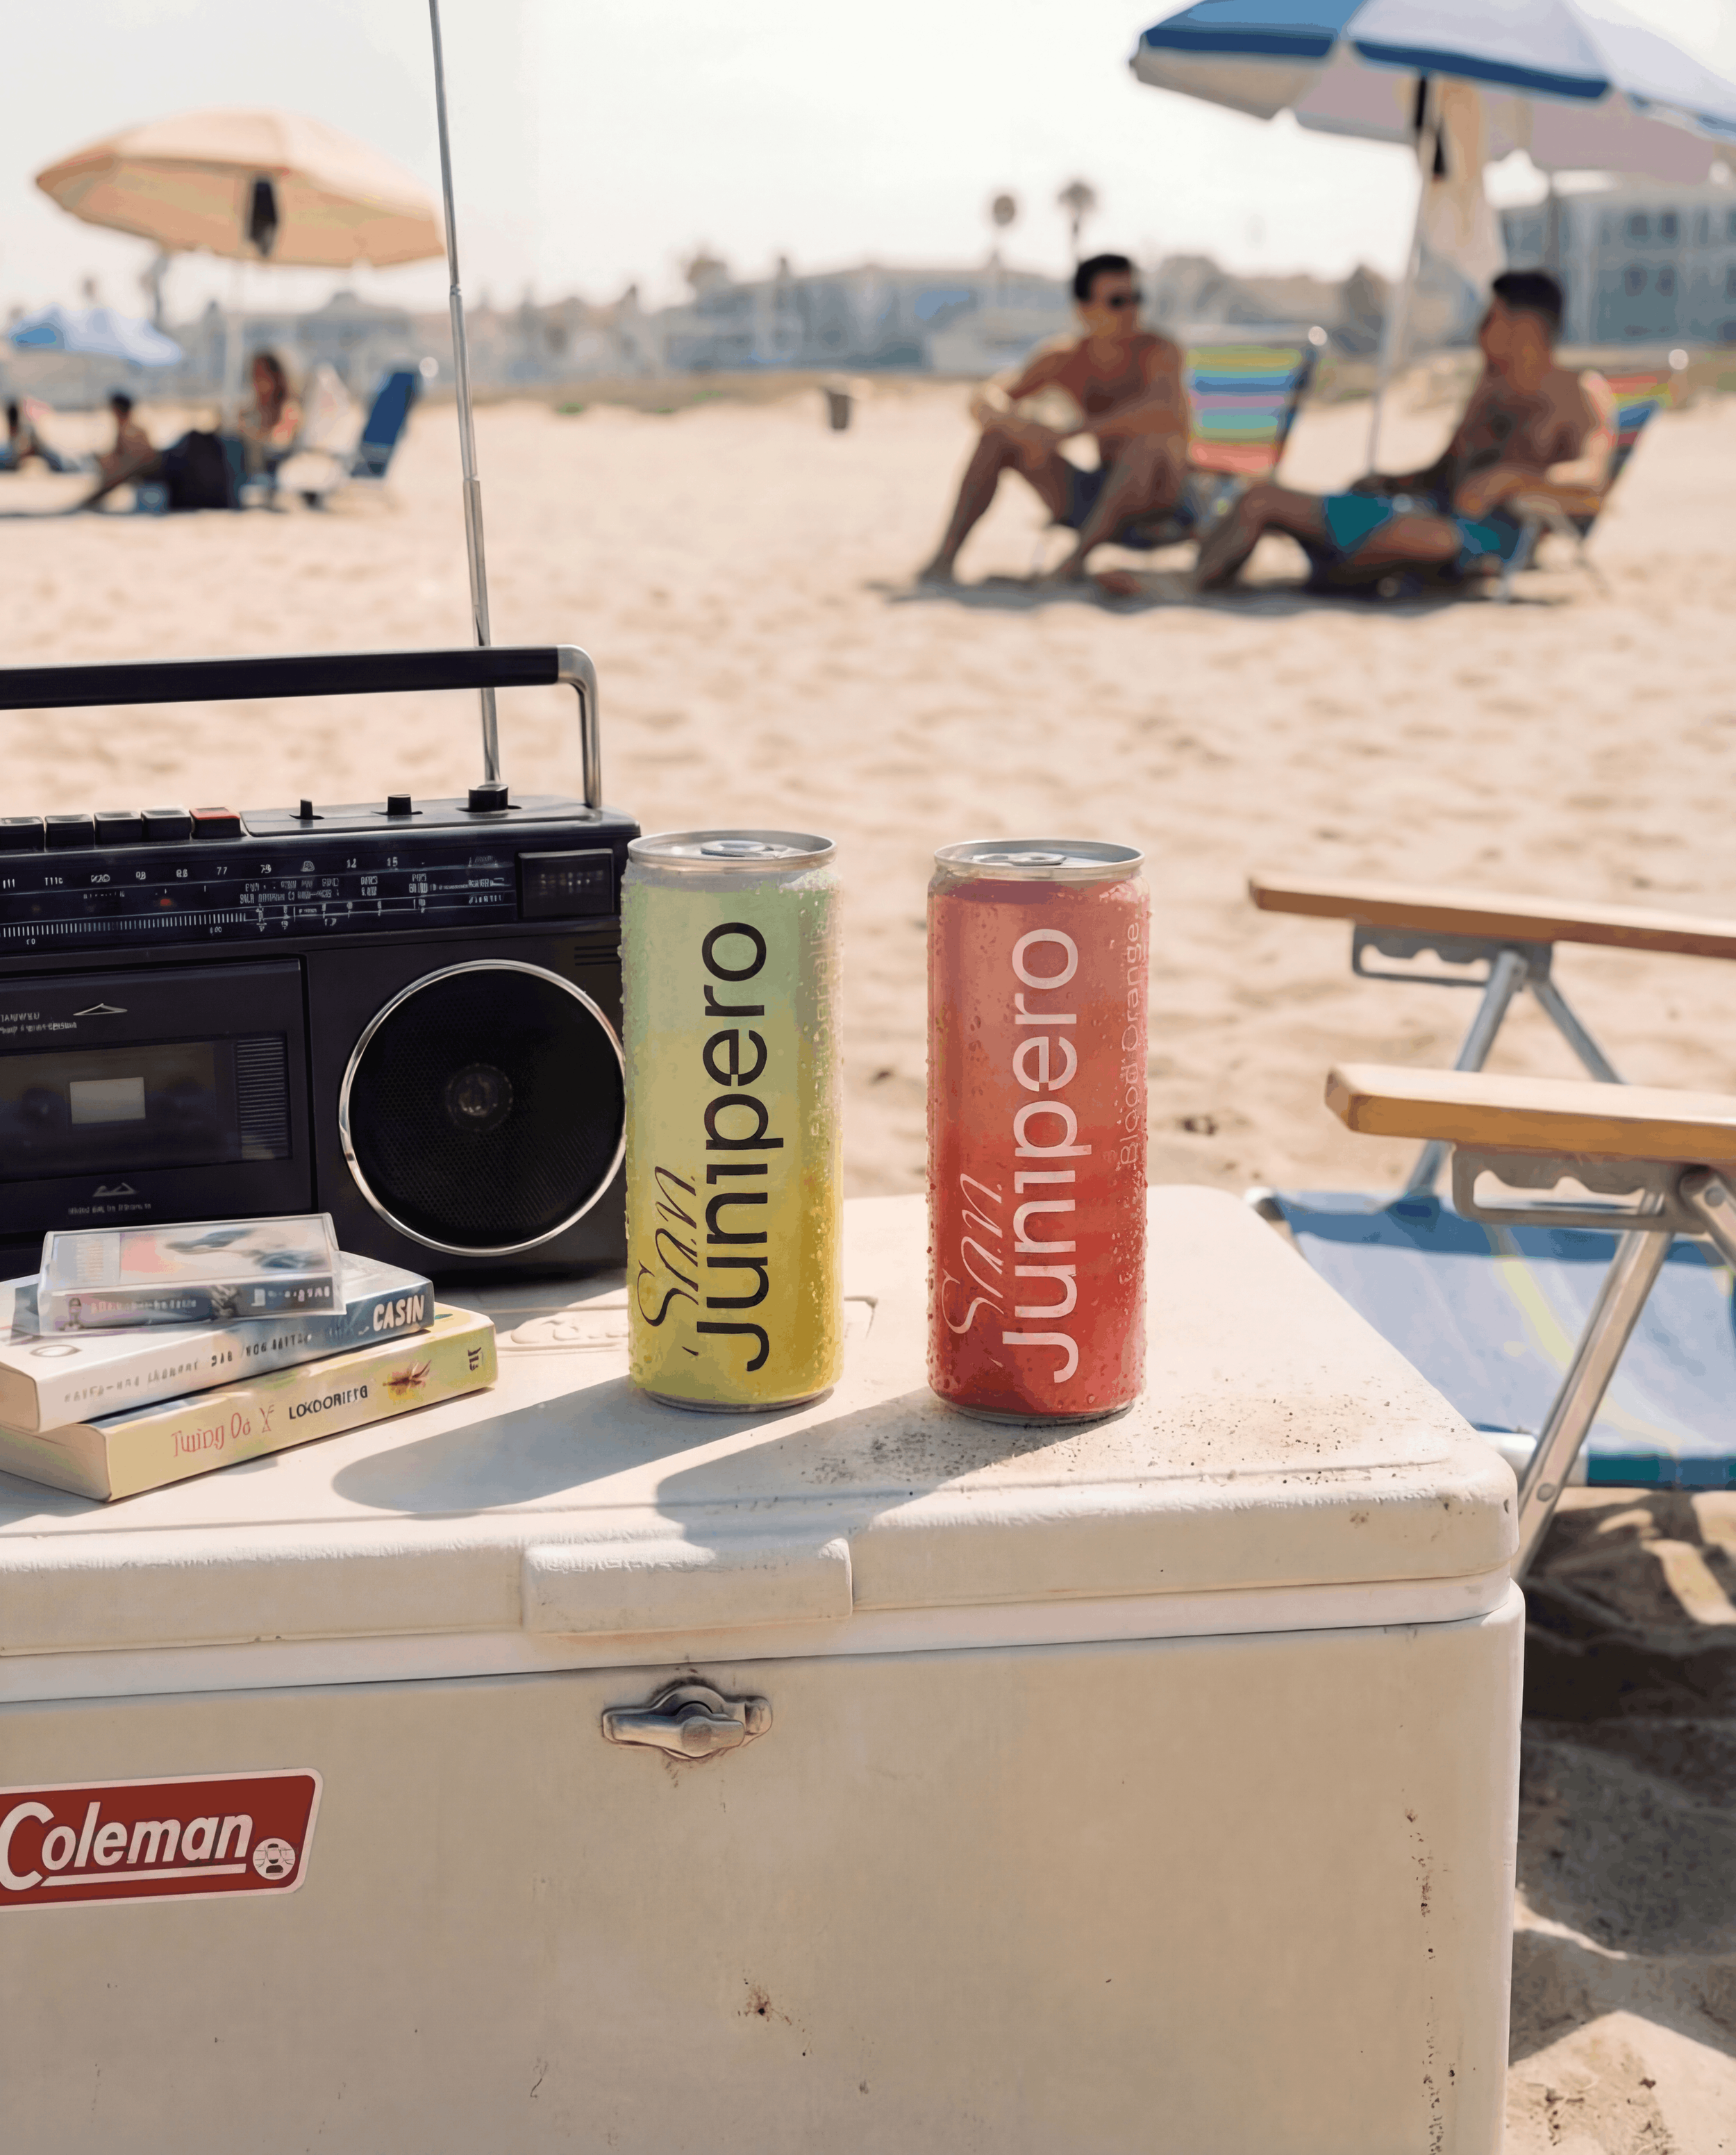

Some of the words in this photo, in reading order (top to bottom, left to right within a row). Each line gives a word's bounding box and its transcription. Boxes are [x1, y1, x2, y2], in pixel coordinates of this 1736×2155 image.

[1121, 922, 1142, 1051] Orange
[696, 922, 784, 1372] Junipero
[1002, 929, 1092, 1383] Junipero
[1119, 1062, 1139, 1165] Blood
[373, 1295, 424, 1331] CASIN
[636, 1165, 699, 1327] San
[941, 1172, 1004, 1335] San
[0, 1802, 253, 1891] Coleman
